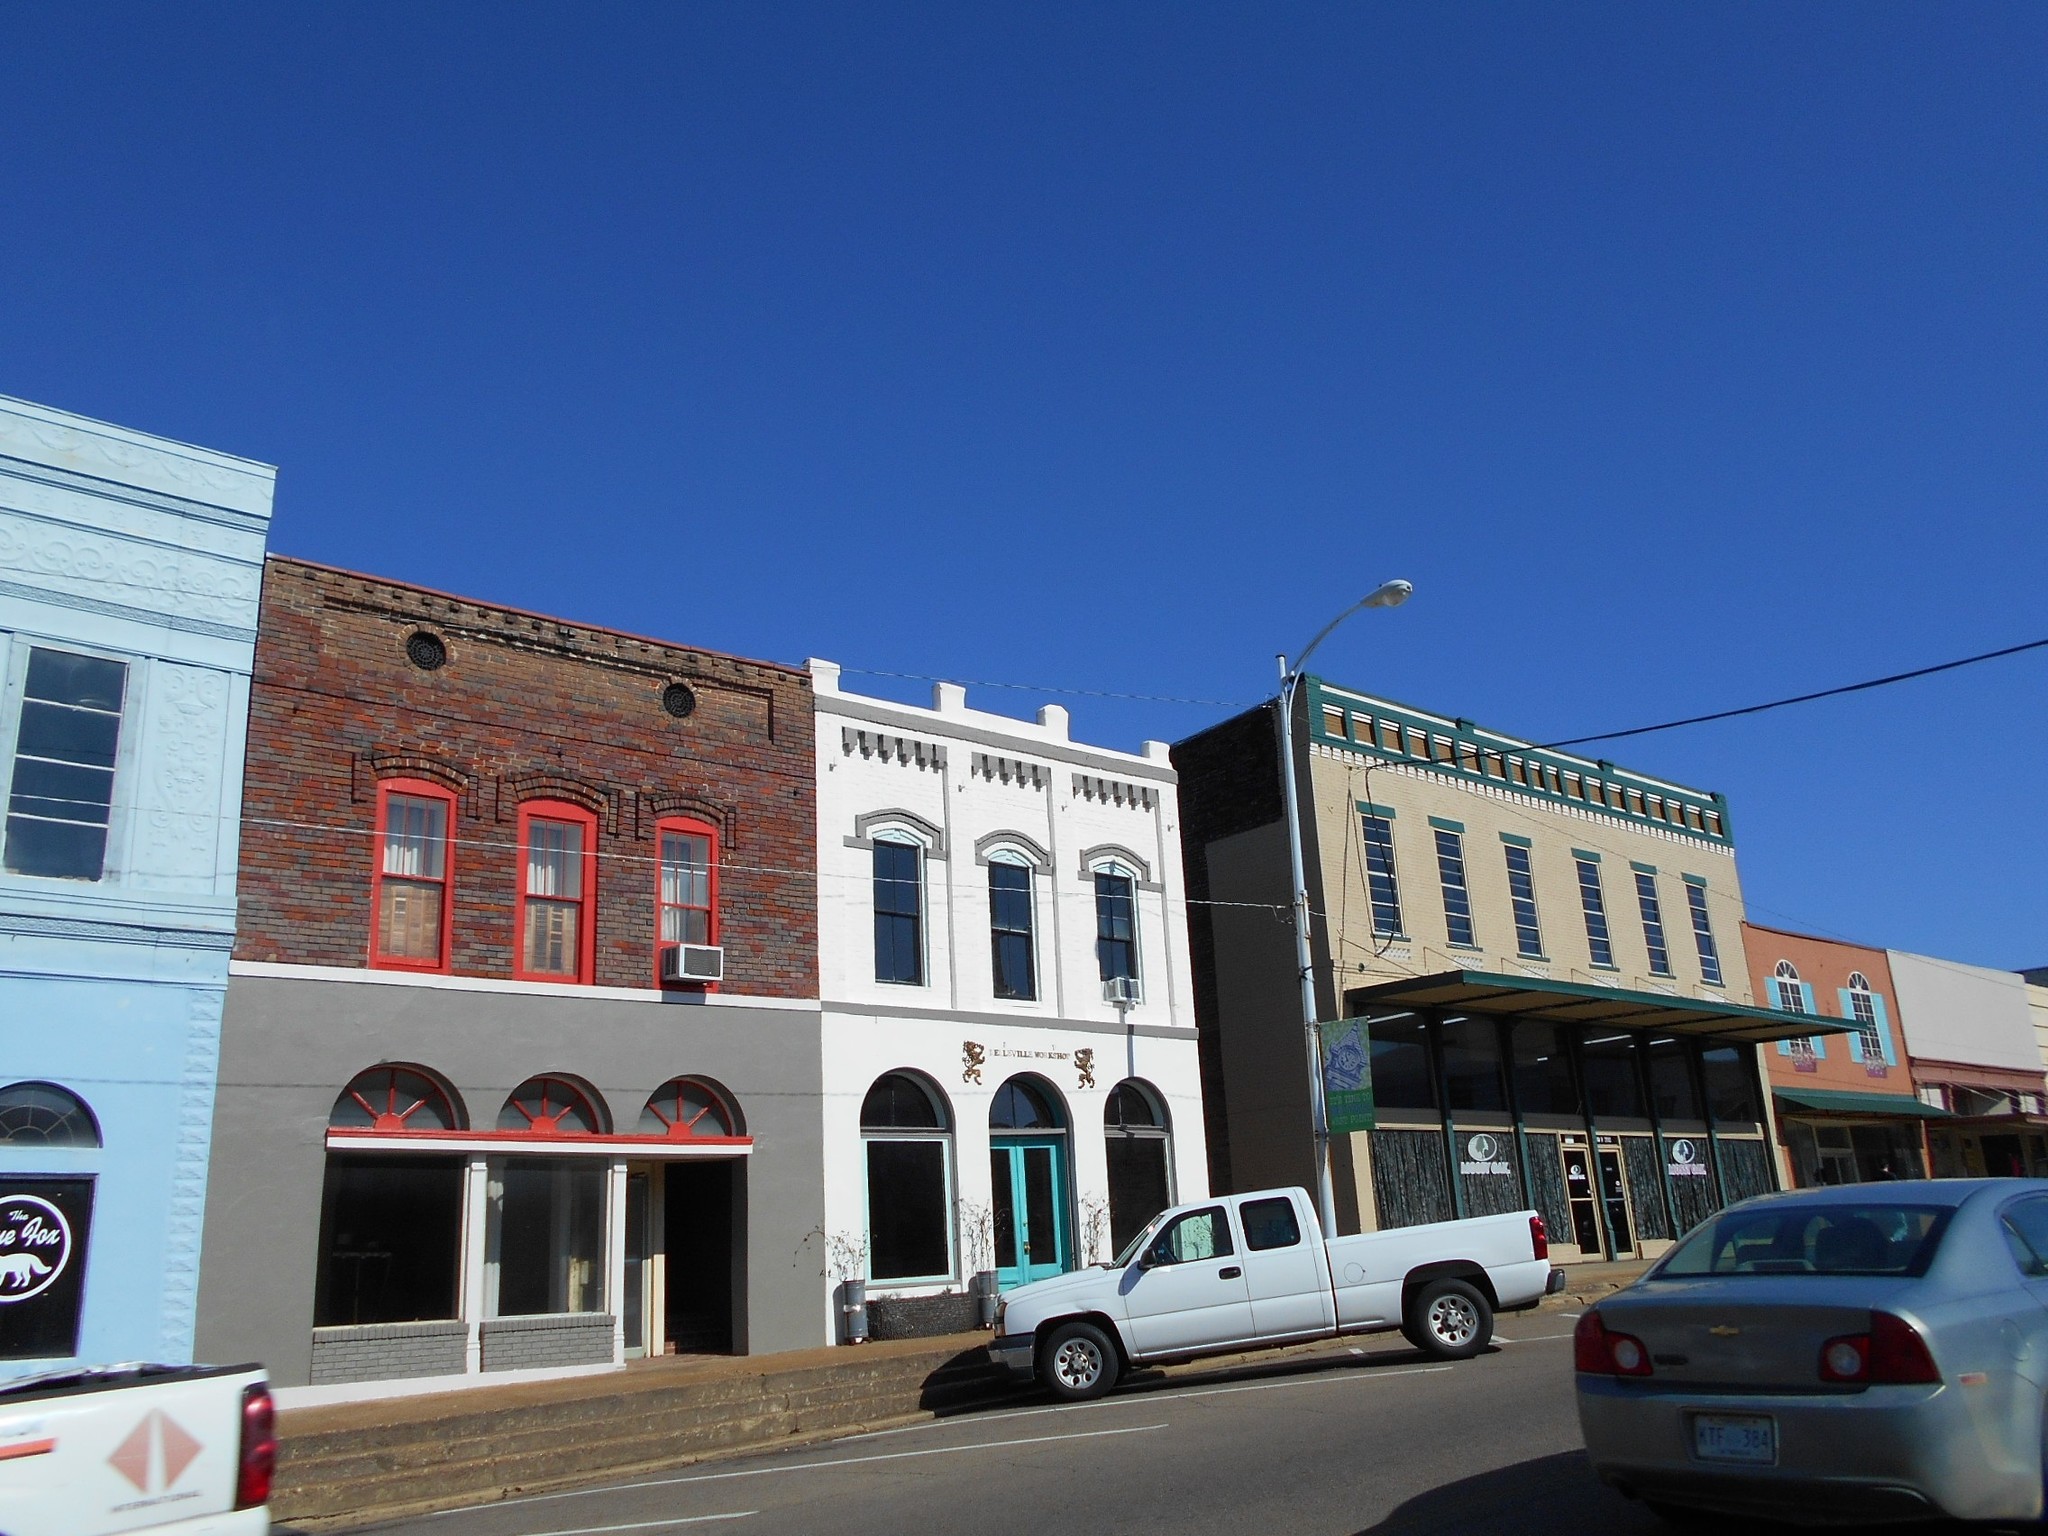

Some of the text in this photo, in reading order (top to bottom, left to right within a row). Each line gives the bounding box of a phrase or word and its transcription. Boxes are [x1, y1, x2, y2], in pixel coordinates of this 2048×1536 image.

[1034, 1051, 1071, 1060] WORKSHOP
[9, 1209, 29, 1221] The
[21, 1216, 61, 1247] Fox
